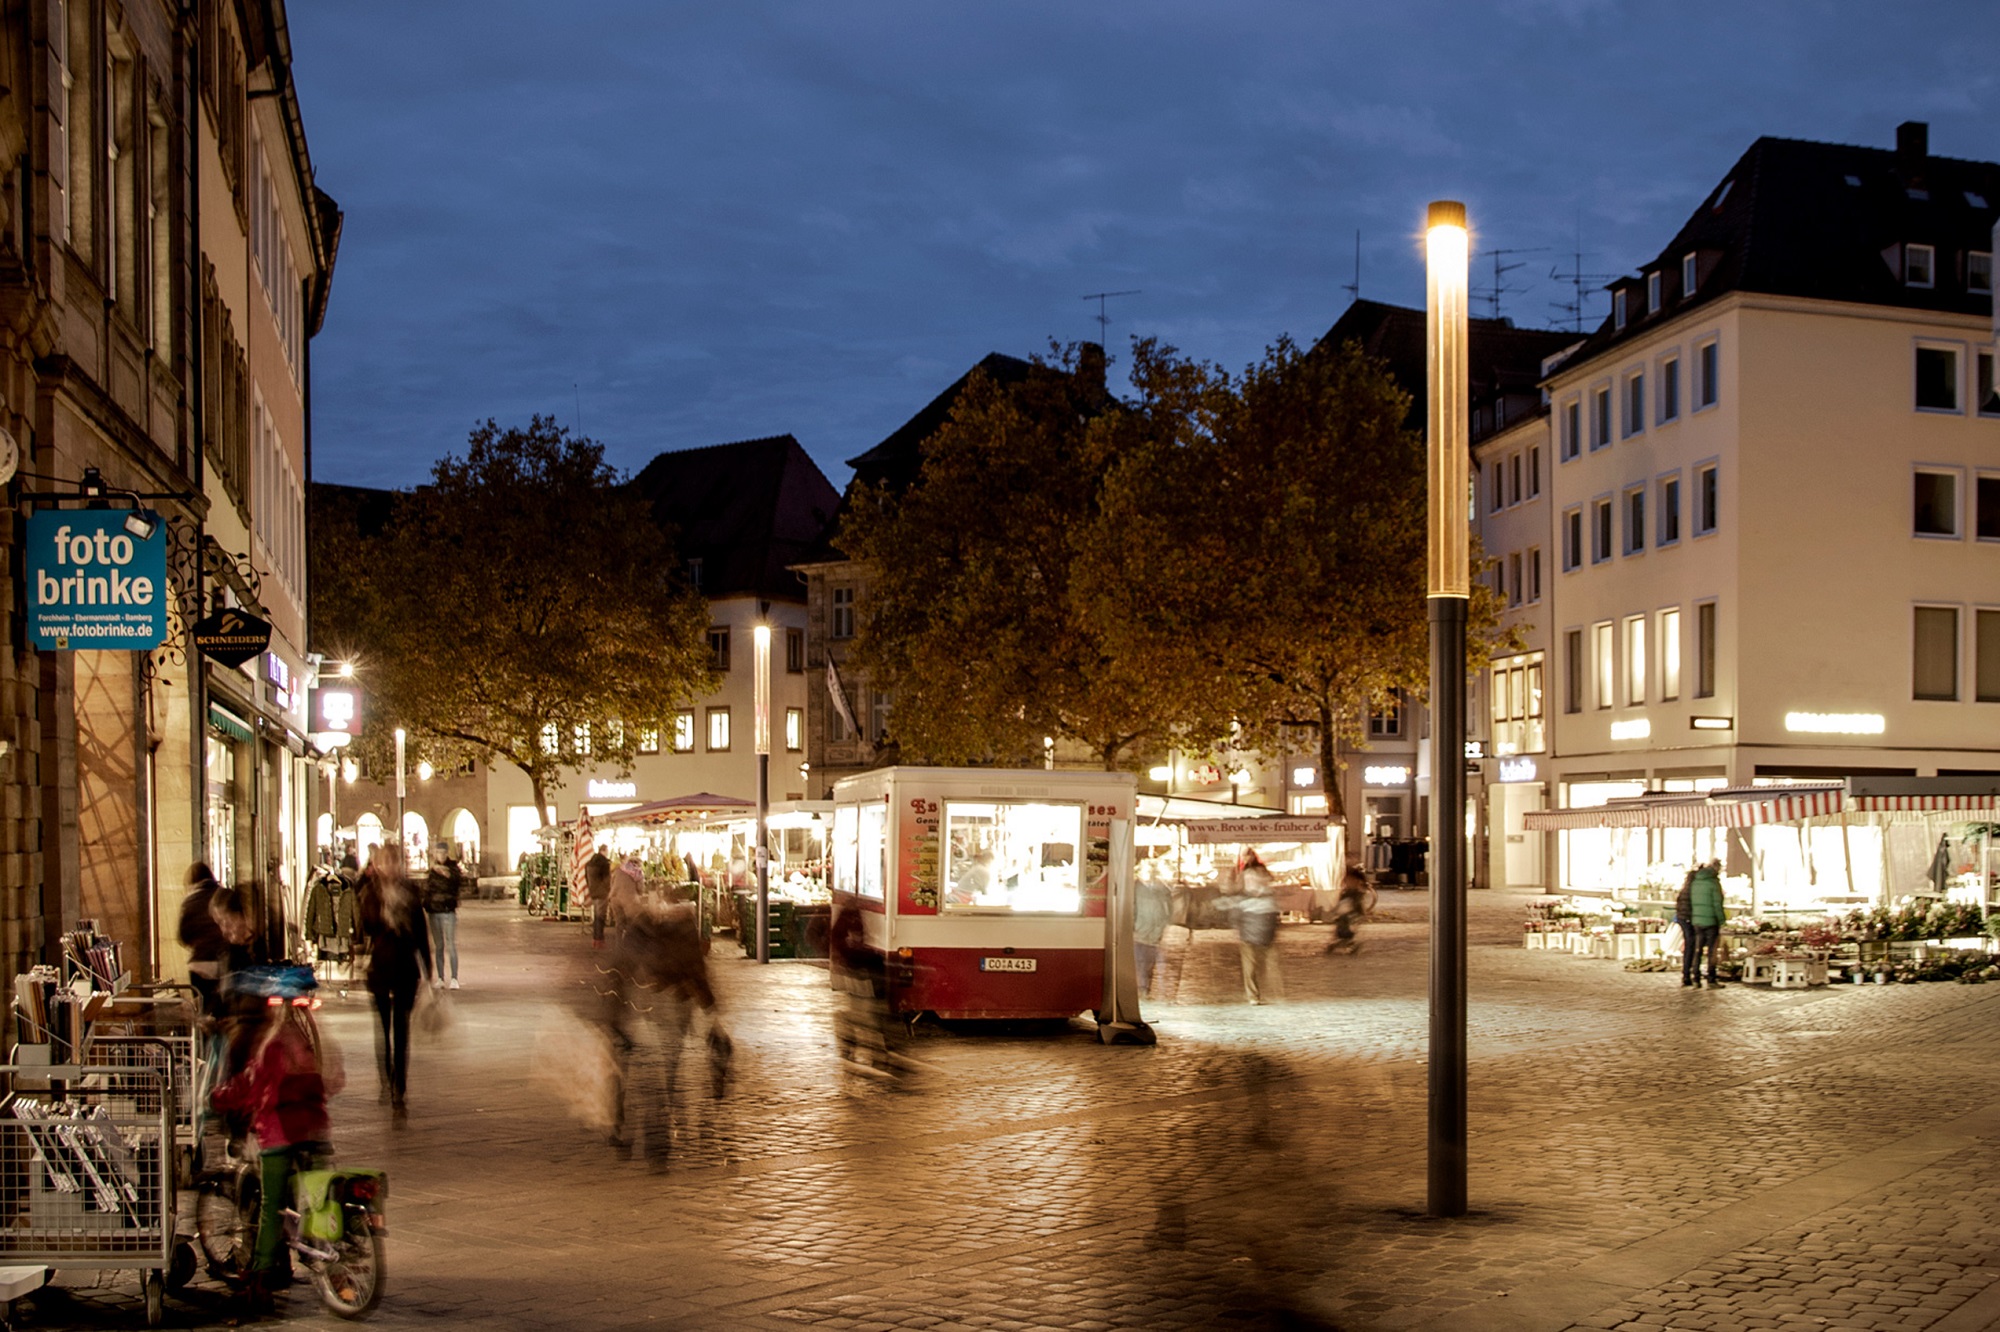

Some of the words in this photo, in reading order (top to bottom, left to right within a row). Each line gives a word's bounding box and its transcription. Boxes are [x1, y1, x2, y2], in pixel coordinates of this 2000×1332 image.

[54, 525, 134, 565] foto
[38, 568, 154, 605] brinke
[125, 613, 153, 623] Bamberg
[40, 623, 153, 637] www.fotobrinke.de
[197, 635, 267, 644] SCHNEIDERS
[1187, 822, 1326, 833] www.Brot-wie-früher.de
[988, 959, 1002, 969] CO
[1007, 959, 1013, 969] A
[1015, 959, 1033, 970] 413
